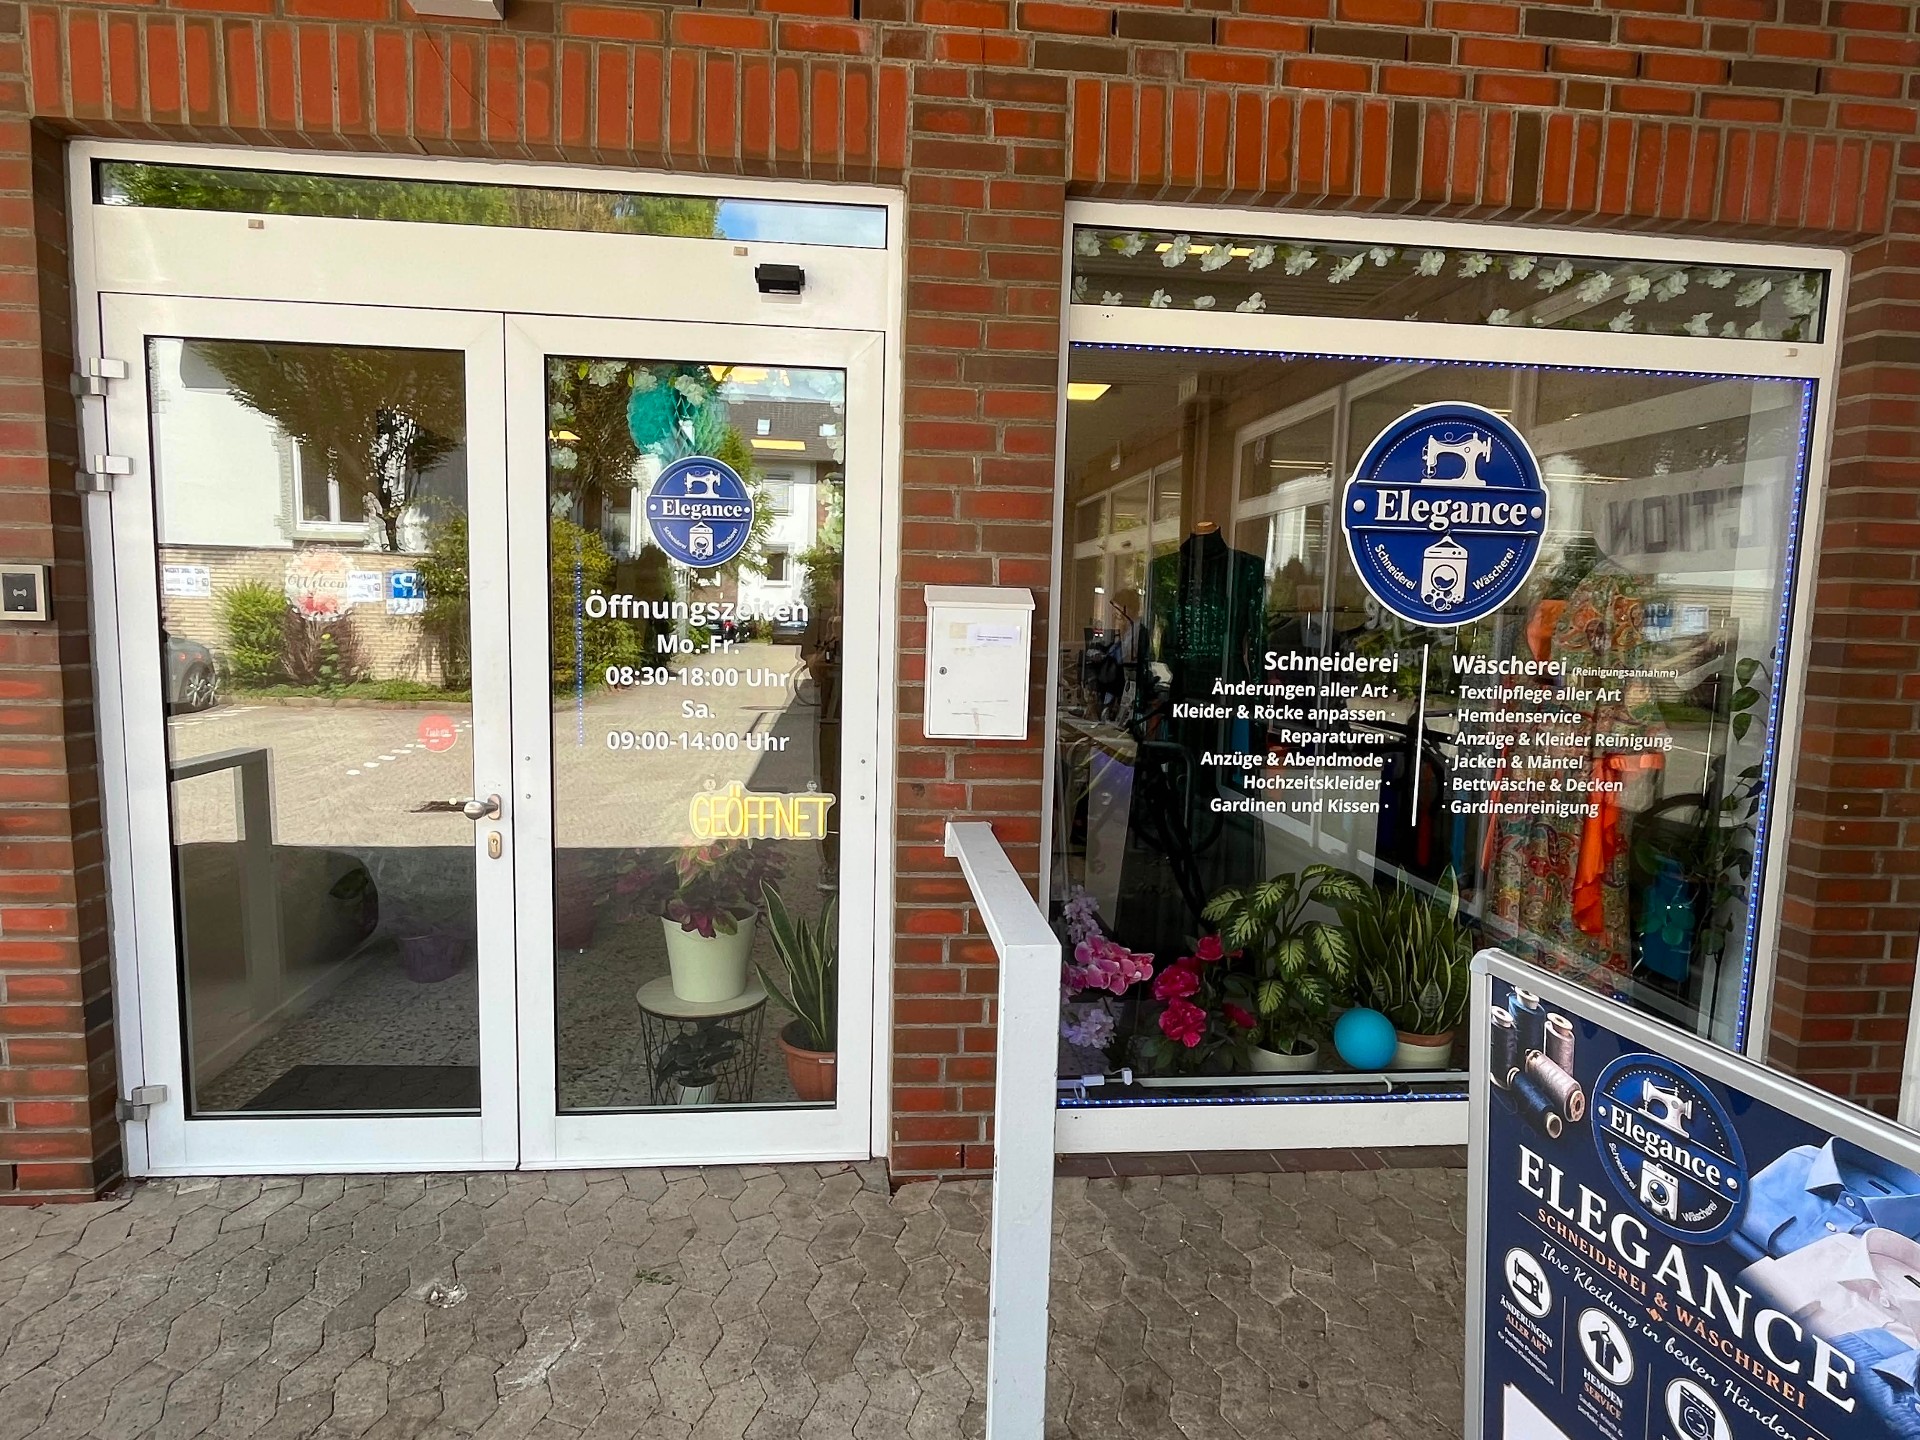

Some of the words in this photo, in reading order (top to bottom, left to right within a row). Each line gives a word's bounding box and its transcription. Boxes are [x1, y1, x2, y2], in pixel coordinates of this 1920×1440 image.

[661, 499, 743, 521] Elegance
[1374, 489, 1527, 531] Elegance
[1374, 543, 1417, 590] Schneiderei
[1472, 548, 1516, 591] Wäscherei
[584, 589, 809, 626] Öffnungszeiten
[657, 635, 740, 654] Mo.-Fr.
[1264, 651, 1399, 673] Schneiderei
[1452, 655, 1567, 676] Wäscherei
[1572, 667, 1679, 679] (Reinigungsannahme)
[605, 666, 740, 687] 08:30-18:00
[746, 667, 790, 687] Uhr
[1211, 678, 1315, 700] Änderungen
[1320, 682, 1358, 698] aller
[1361, 683, 1389, 698] Art
[1459, 685, 1552, 702] Textilpflege
[1556, 686, 1593, 701] aller
[1596, 687, 1621, 702] Art
[681, 700, 716, 719] Sa.
[1172, 704, 1232, 719] Kleider
[1236, 705, 1250, 719] &
[1254, 705, 1303, 720] Röcke
[1307, 709, 1386, 724] anpassen
[1457, 708, 1582, 724] Hemdenservice
[606, 731, 740, 751] 09:00-14:00
[746, 733, 790, 752] Uhr
[1281, 729, 1385, 747] Reparaturen
[1454, 731, 1514, 749] Anzüge
[1518, 733, 1530, 747] &
[1535, 732, 1591, 747] Kleider
[1595, 733, 1673, 751] Reinigung
[1201, 752, 1262, 769] Anzüge
[1266, 753, 1279, 766] &
[1283, 753, 1383, 767] Abendmode
[1451, 755, 1507, 771] Jacken
[1510, 755, 1523, 769] &
[1527, 755, 1584, 769] Mäntel
[1244, 775, 1382, 791] Hochzeitskleider
[1452, 777, 1545, 792] Bettwäsche
[1549, 779, 1562, 792] &
[1566, 779, 1623, 792] Decken
[692, 787, 833, 838] GEÖFFNET
[1210, 798, 1288, 812] Gardinen
[1292, 798, 1323, 812] und
[1327, 799, 1380, 813] Kissen
[1450, 800, 1600, 818] Gardinenreinigung
[1610, 1104, 1721, 1187] Elegance
[1682, 1199, 1718, 1223] Wäscherei
[1518, 1144, 1855, 1414] ELEGANCE
[1537, 1208, 1647, 1296] SCHNEIDEREI
[1653, 1292, 1668, 1312] &
[1676, 1304, 1805, 1409] WÄSCHEREI
[1500, 1294, 1553, 1348] ÄNDERUNGEN
[1506, 1313, 1529, 1340] ALLER
[1531, 1335, 1546, 1354] ART
[1540, 1241, 1570, 1274] Ihre
[1574, 1266, 1639, 1328] Kleidung
[1642, 1323, 1661, 1343] in
[1664, 1337, 1718, 1387] besten
[1723, 1379, 1797, 1440] Händen
[1583, 1367, 1623, 1408] HEMDEN
[1584, 1382, 1622, 1420] SERVICE
